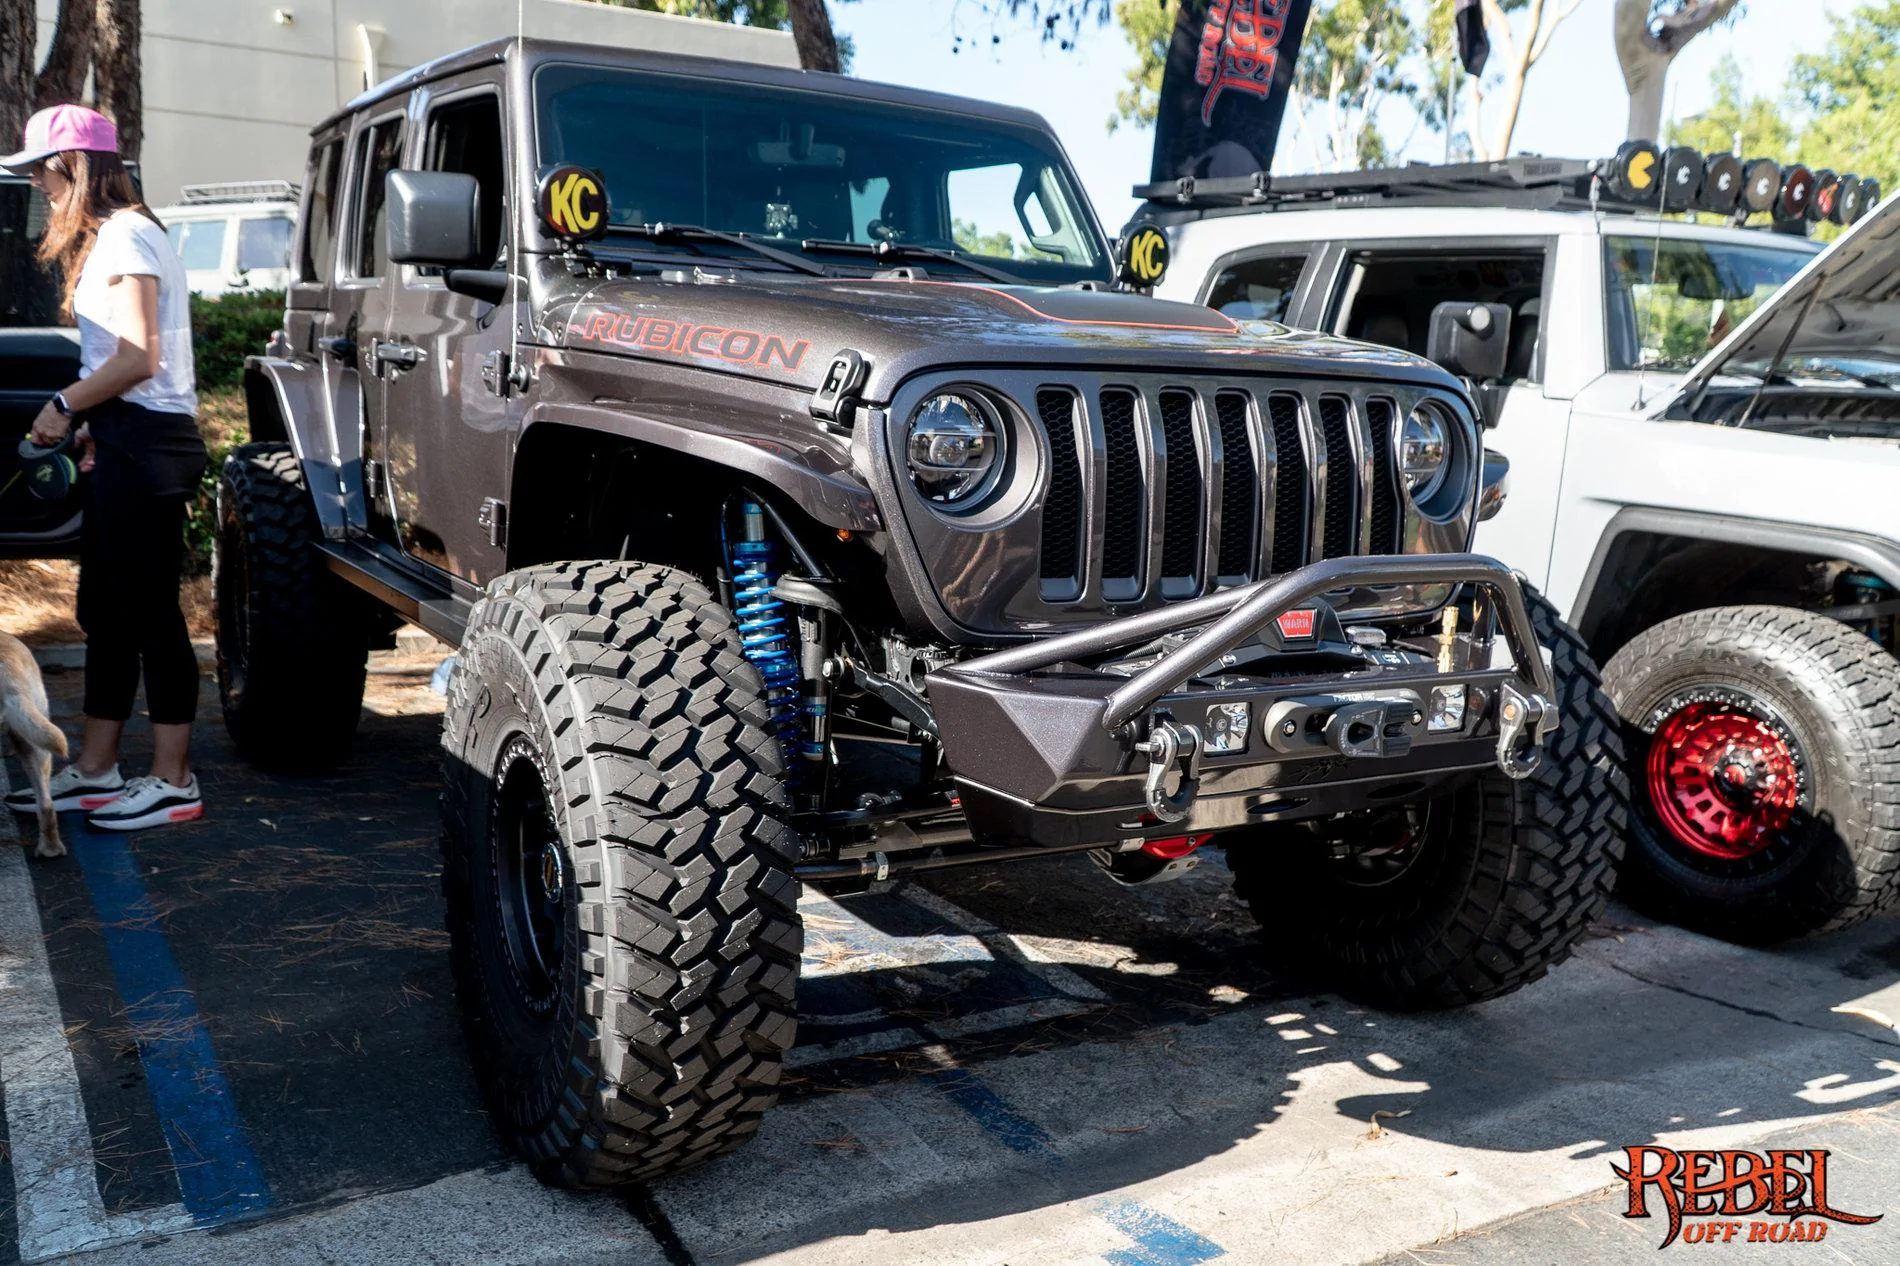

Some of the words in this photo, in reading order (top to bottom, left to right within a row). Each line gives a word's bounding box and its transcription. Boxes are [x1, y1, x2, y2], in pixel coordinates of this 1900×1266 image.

[551, 173, 599, 233] KC
[1131, 230, 1165, 279] KC
[583, 312, 812, 372] RUBICON
[1283, 618, 1309, 628] WARN
